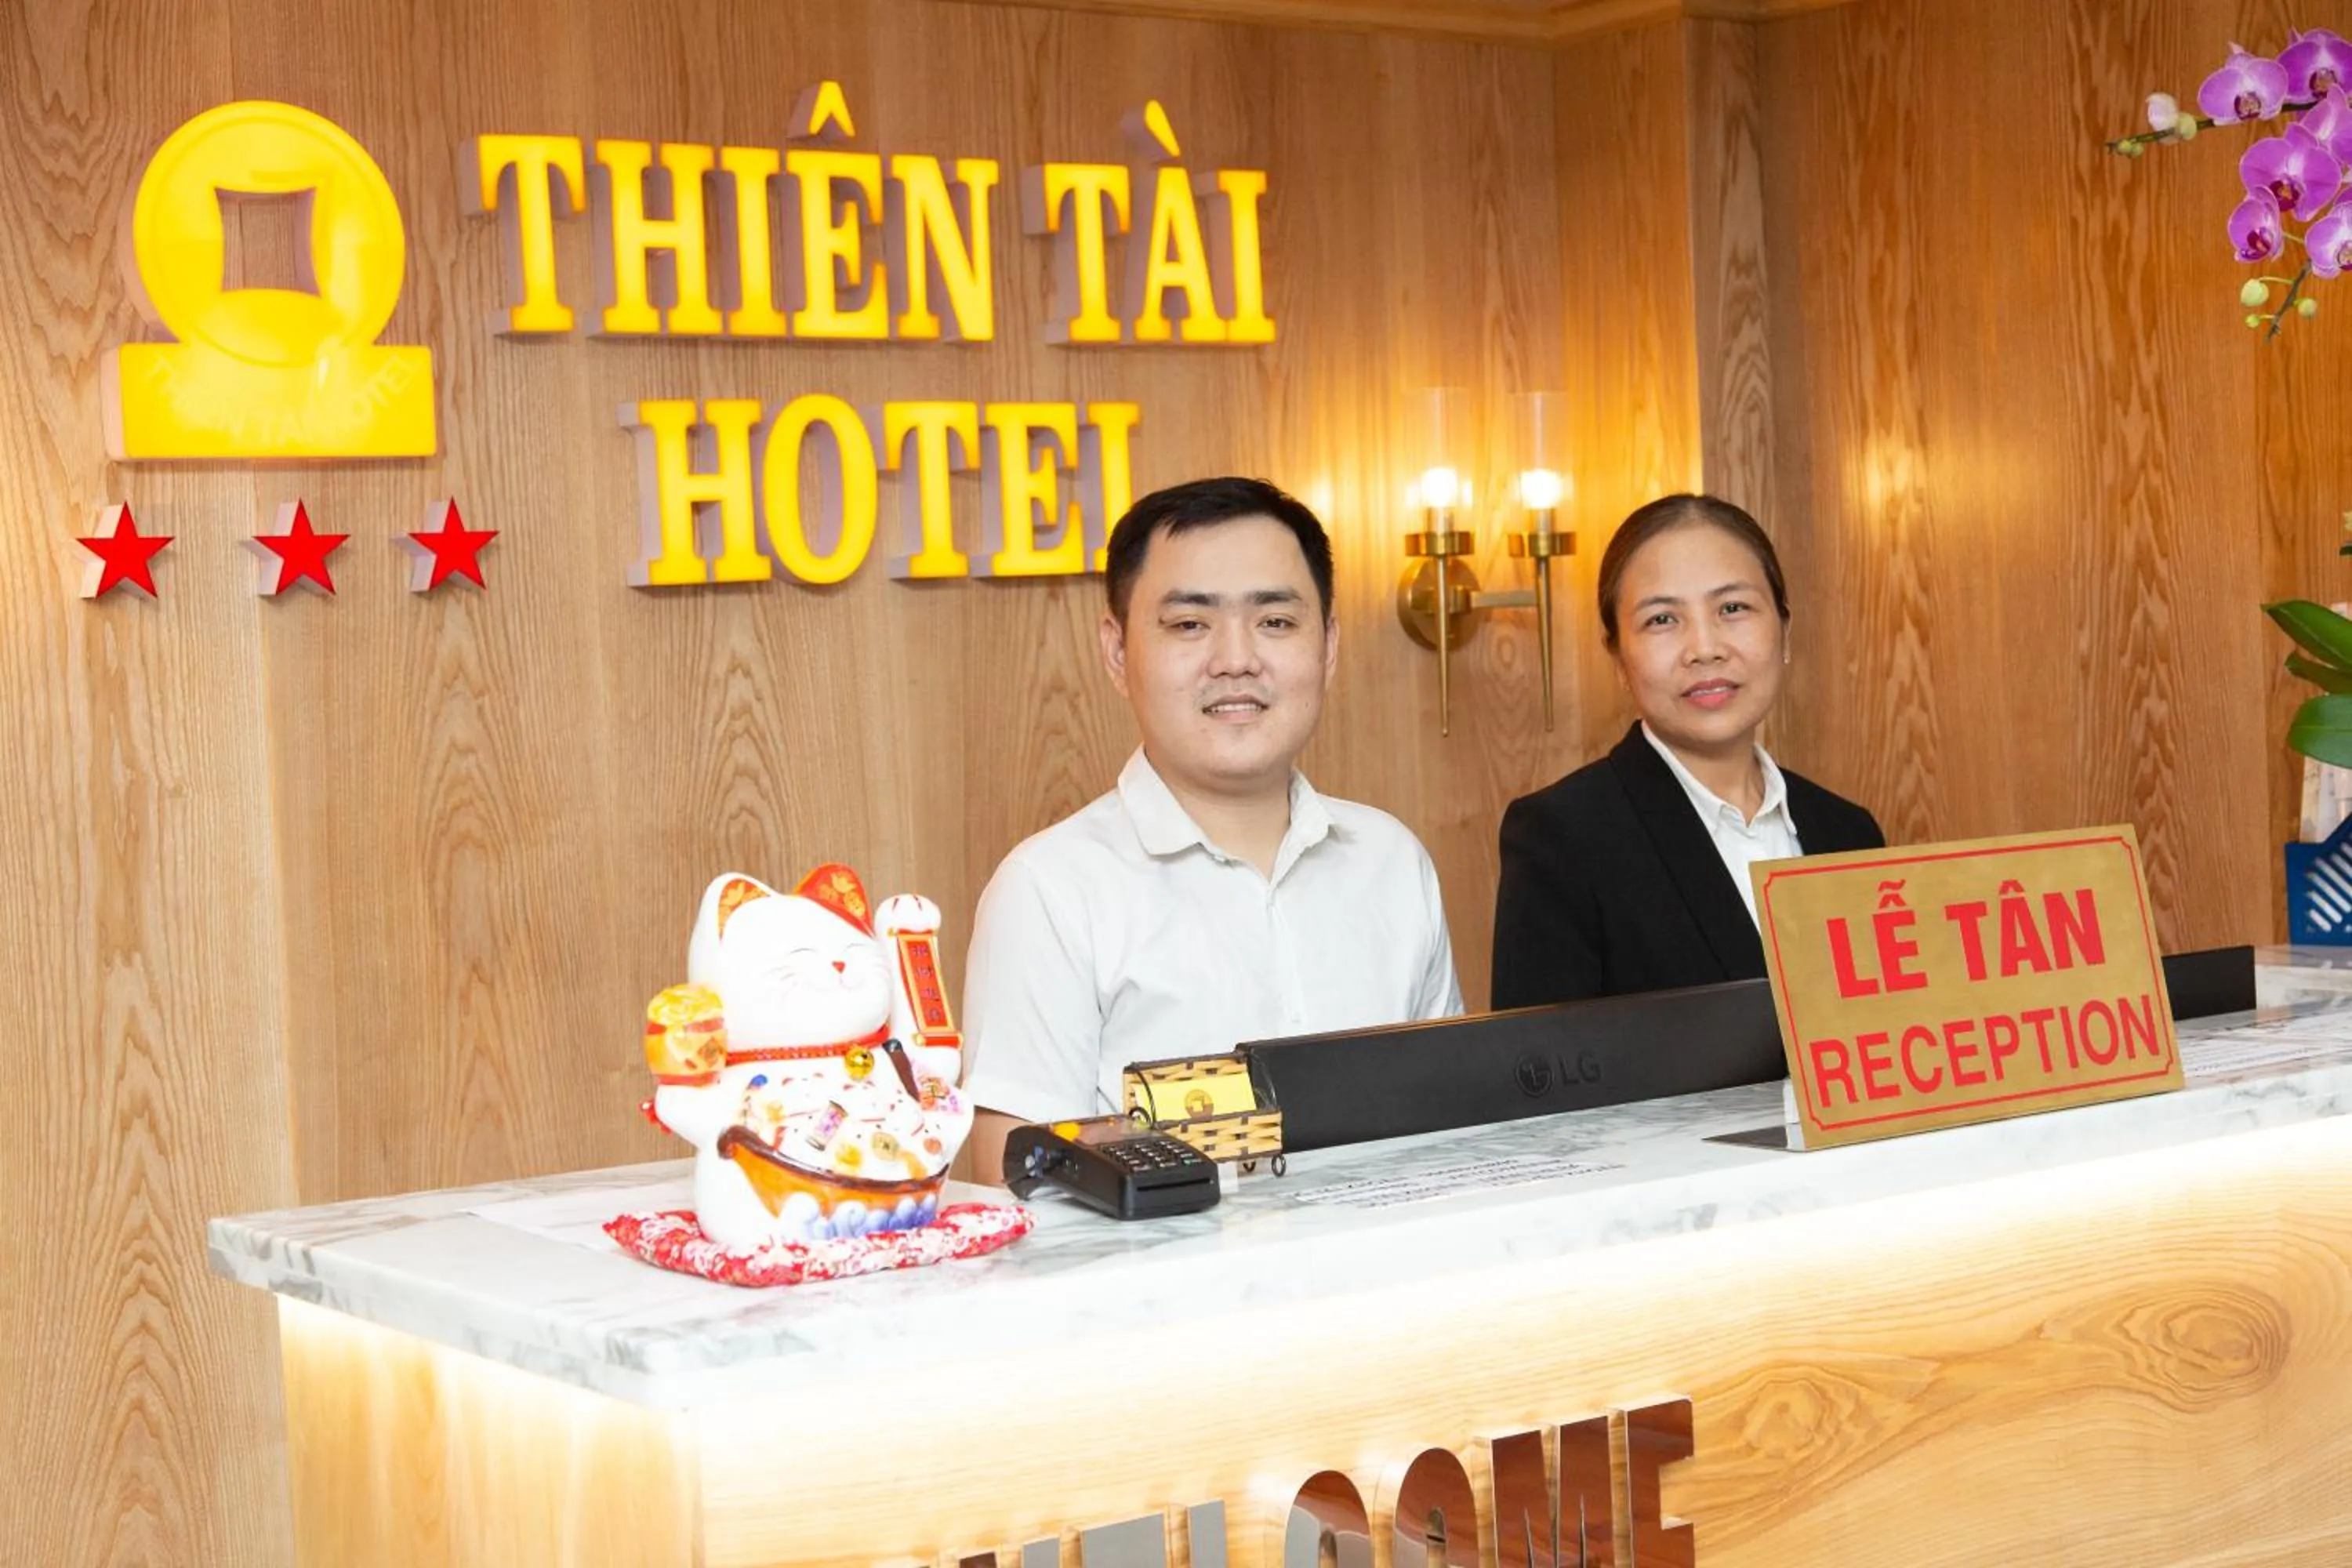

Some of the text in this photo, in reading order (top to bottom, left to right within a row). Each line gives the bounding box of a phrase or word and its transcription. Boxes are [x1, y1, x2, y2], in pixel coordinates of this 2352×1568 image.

[479, 82, 1276, 343] THIÊN TÀI
[1826, 879, 2106, 999] LỄ TÂN
[1558, 1051, 1602, 1085] LG
[1809, 994, 2160, 1108] RECEPTION
